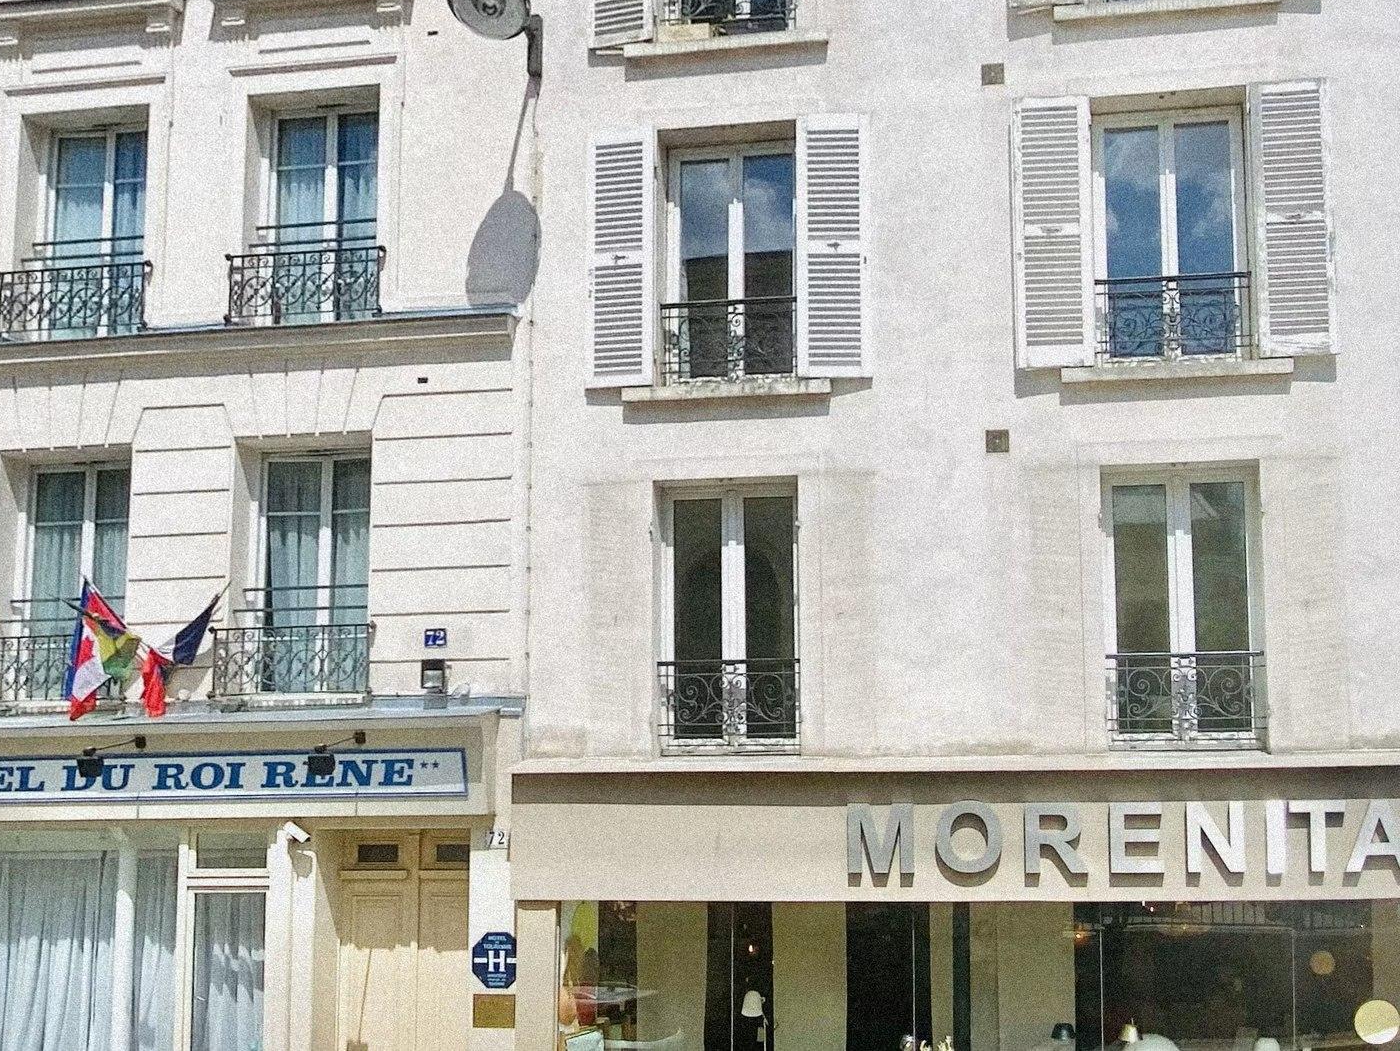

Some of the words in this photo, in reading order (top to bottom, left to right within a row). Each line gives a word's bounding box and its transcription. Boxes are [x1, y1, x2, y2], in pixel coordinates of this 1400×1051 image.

[426, 630, 445, 645] 72
[61, 764, 135, 791] DU
[152, 762, 246, 790] ROI
[489, 831, 505, 845] 72
[846, 799, 1400, 875] MORENITA
[488, 950, 506, 972] H
